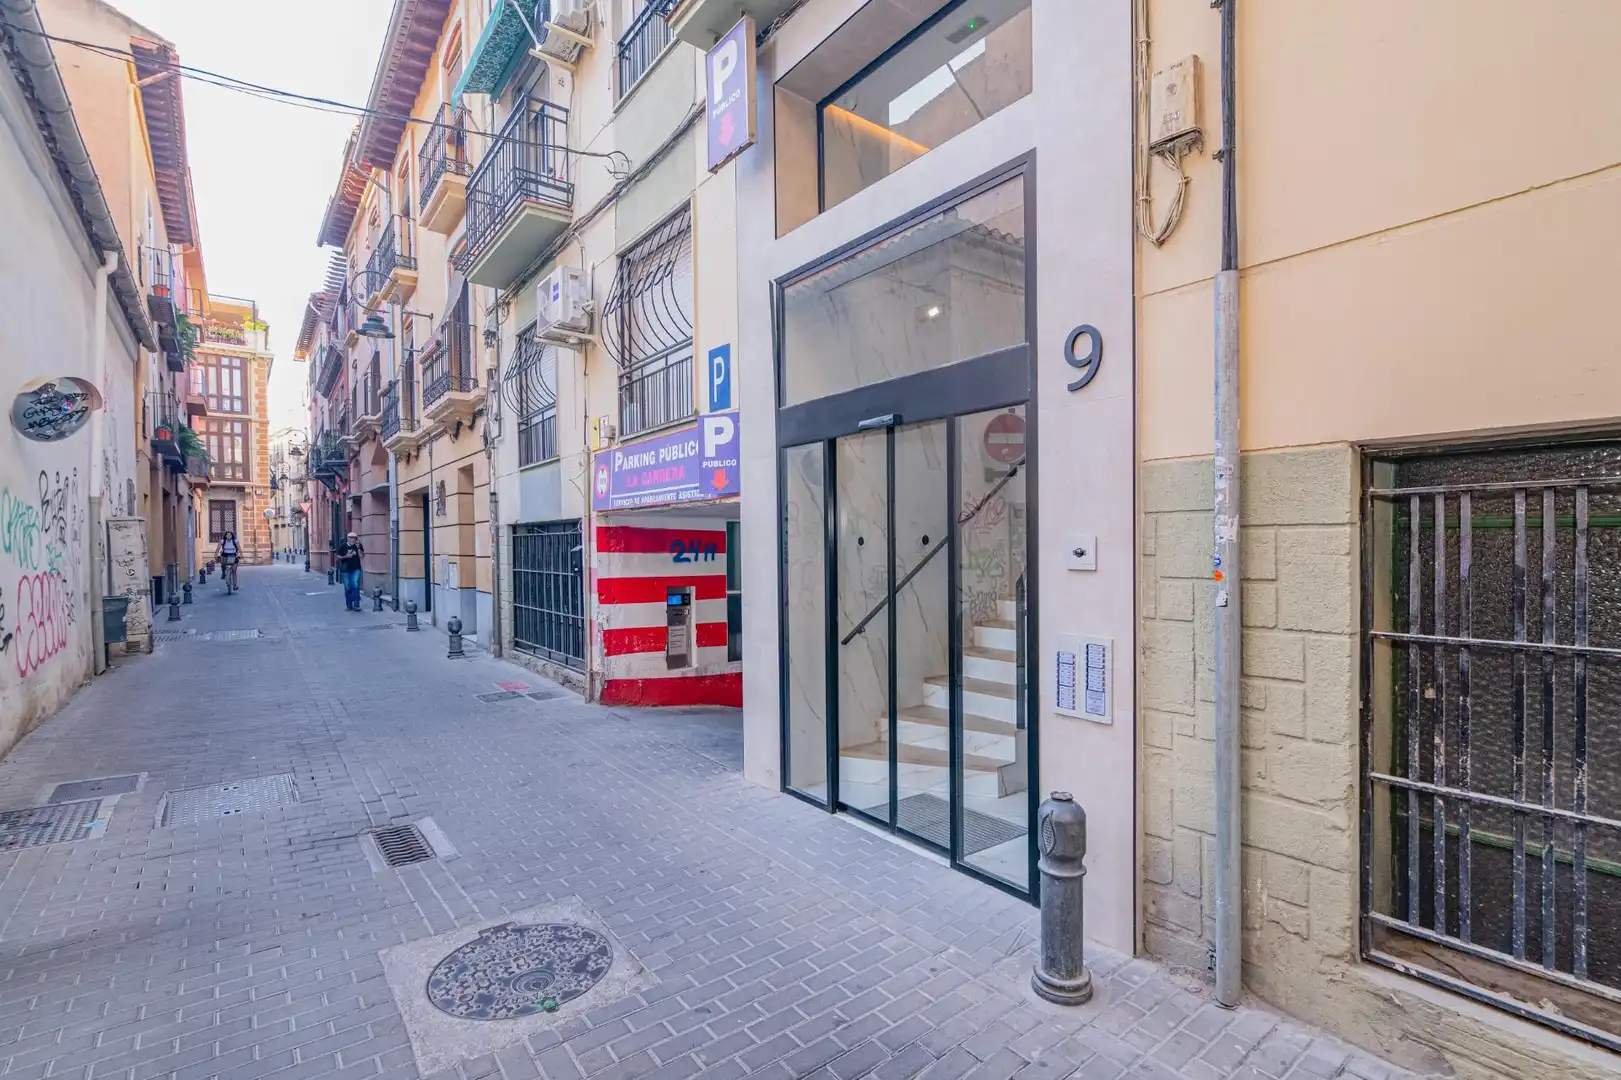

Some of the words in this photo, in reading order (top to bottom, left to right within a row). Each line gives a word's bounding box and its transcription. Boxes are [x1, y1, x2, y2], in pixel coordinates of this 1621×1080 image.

[713, 40, 738, 105] P
[713, 356, 725, 403] P
[1064, 324, 1103, 392] 9
[703, 415, 735, 458] P
[614, 451, 656, 473] PARKING
